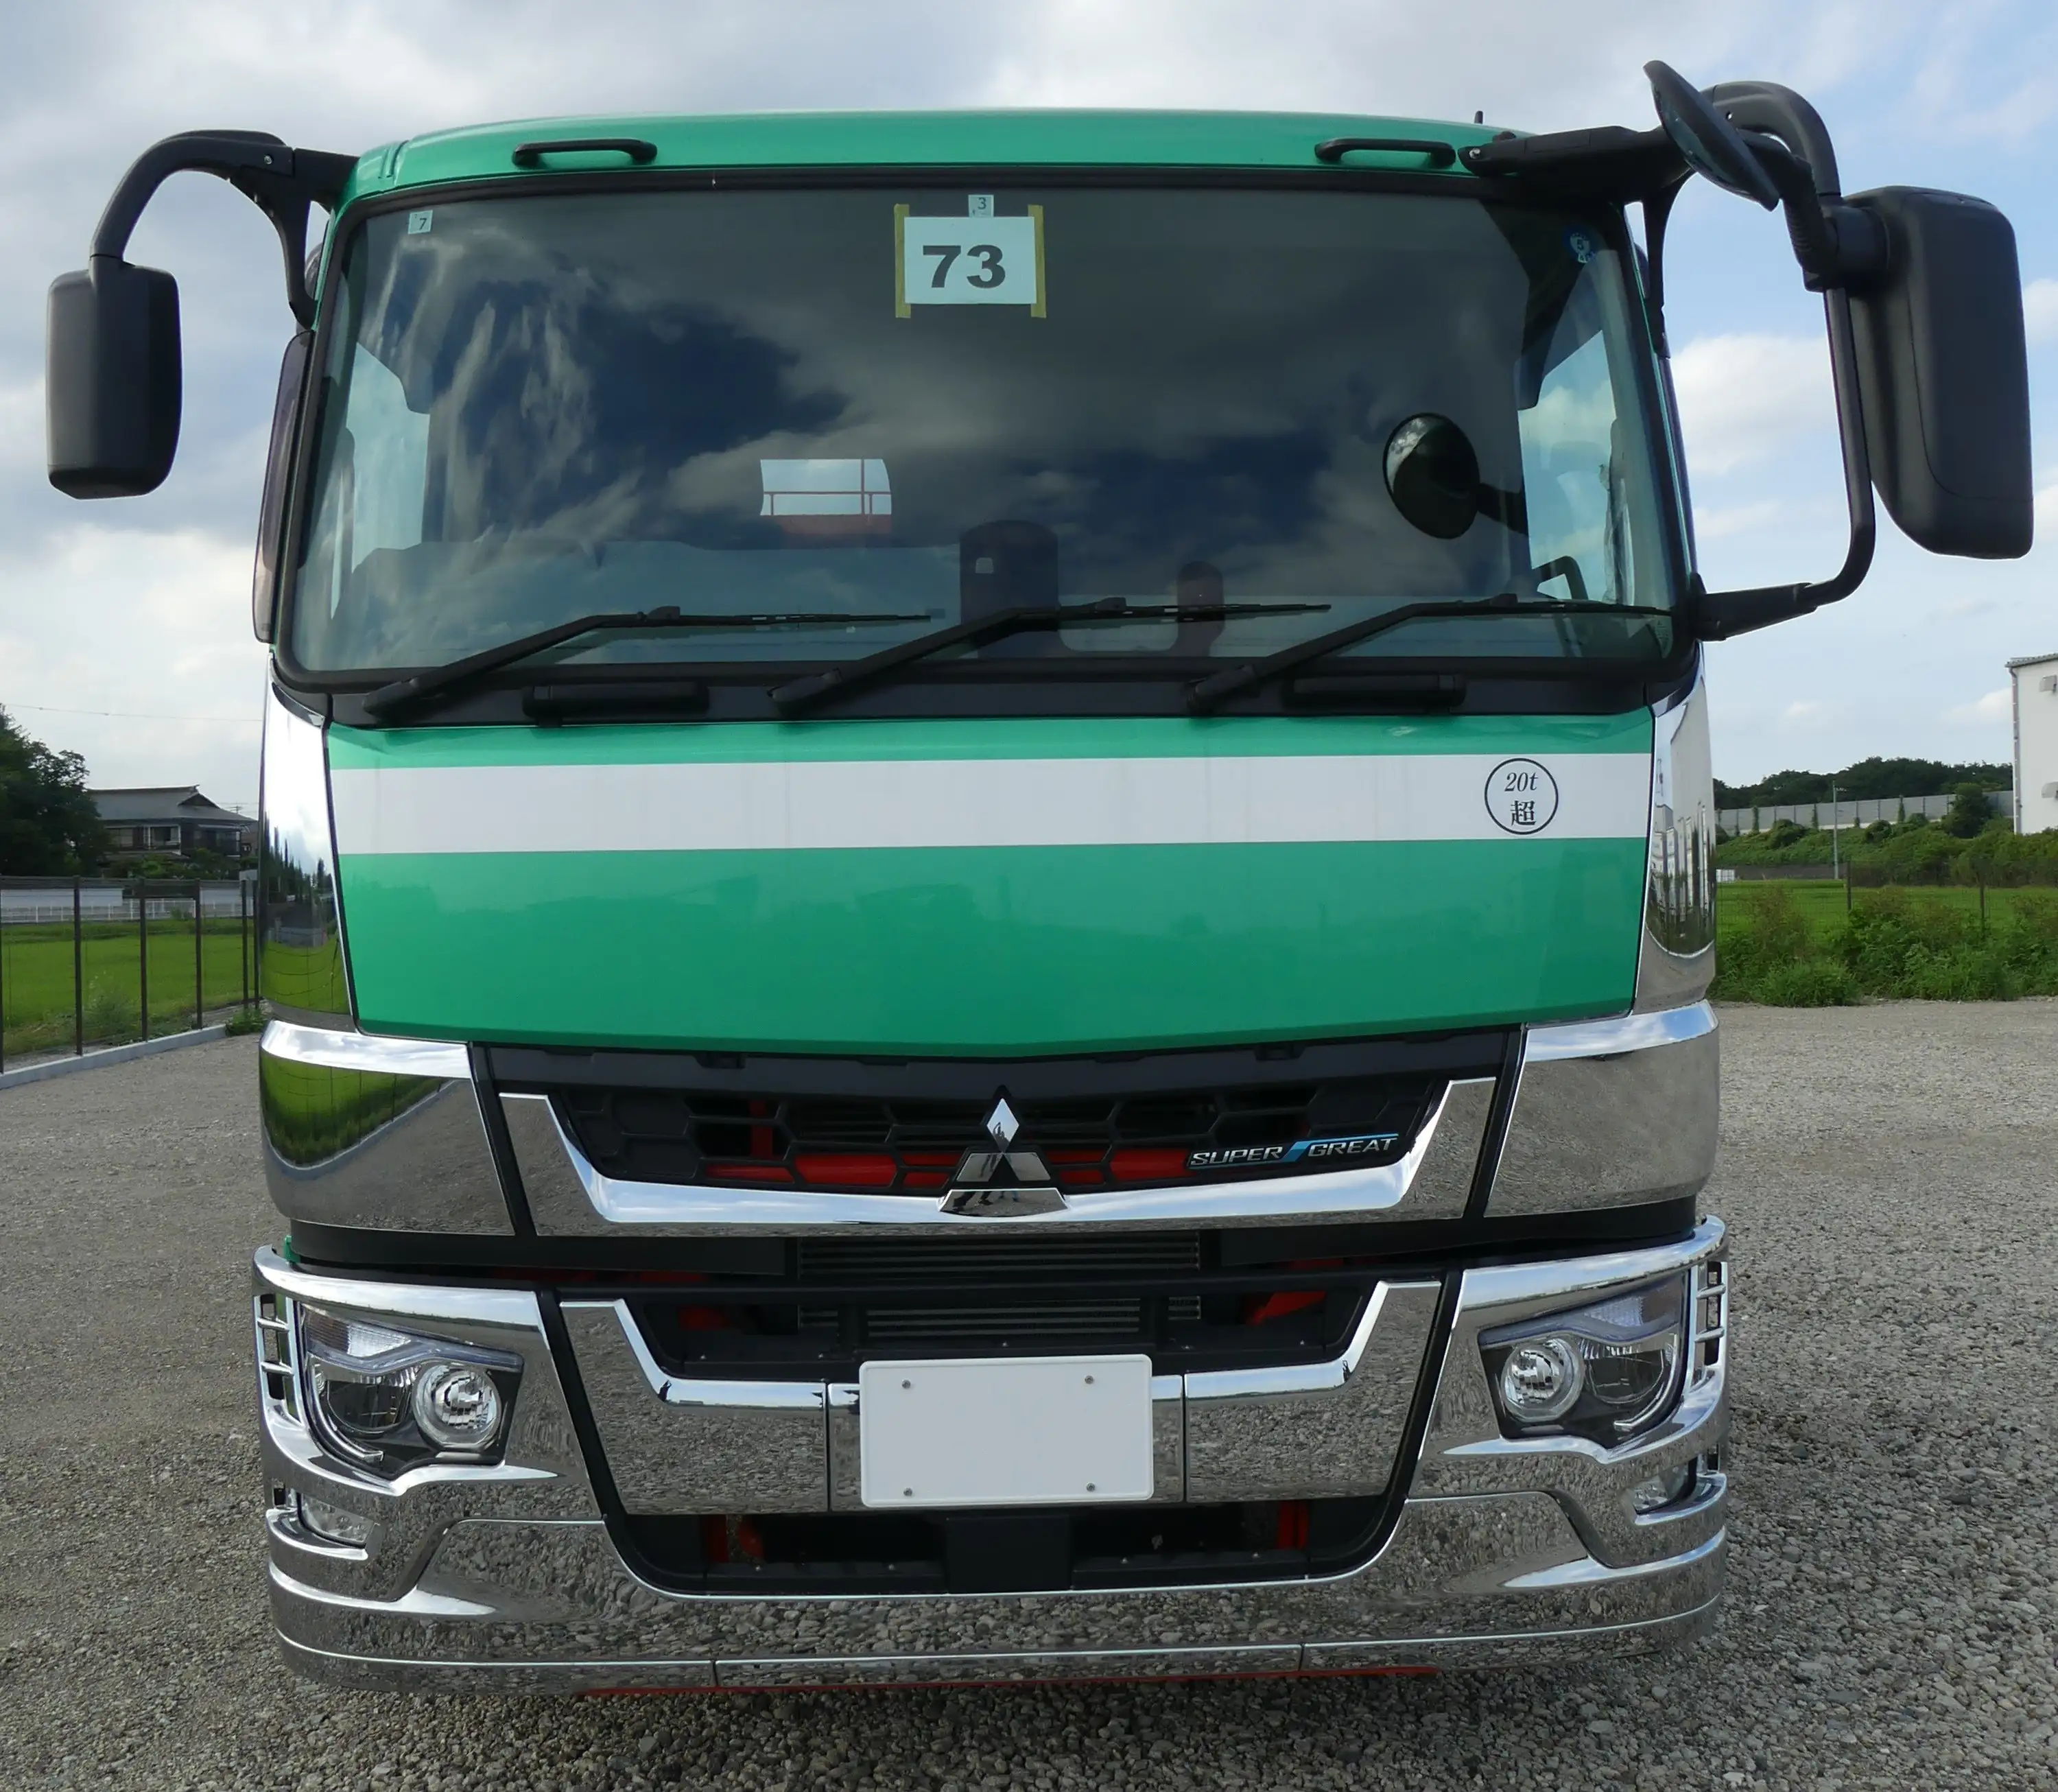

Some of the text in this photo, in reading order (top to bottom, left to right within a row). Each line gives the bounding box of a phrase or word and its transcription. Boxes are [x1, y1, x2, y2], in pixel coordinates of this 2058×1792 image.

[978, 197, 986, 210] 3
[419, 217, 427, 230] 7
[923, 244, 1006, 289] 73
[1504, 772, 1539, 792] 20t
[1510, 800, 1536, 826] 超
[1190, 1137, 1398, 1166] SUPER GREAT
